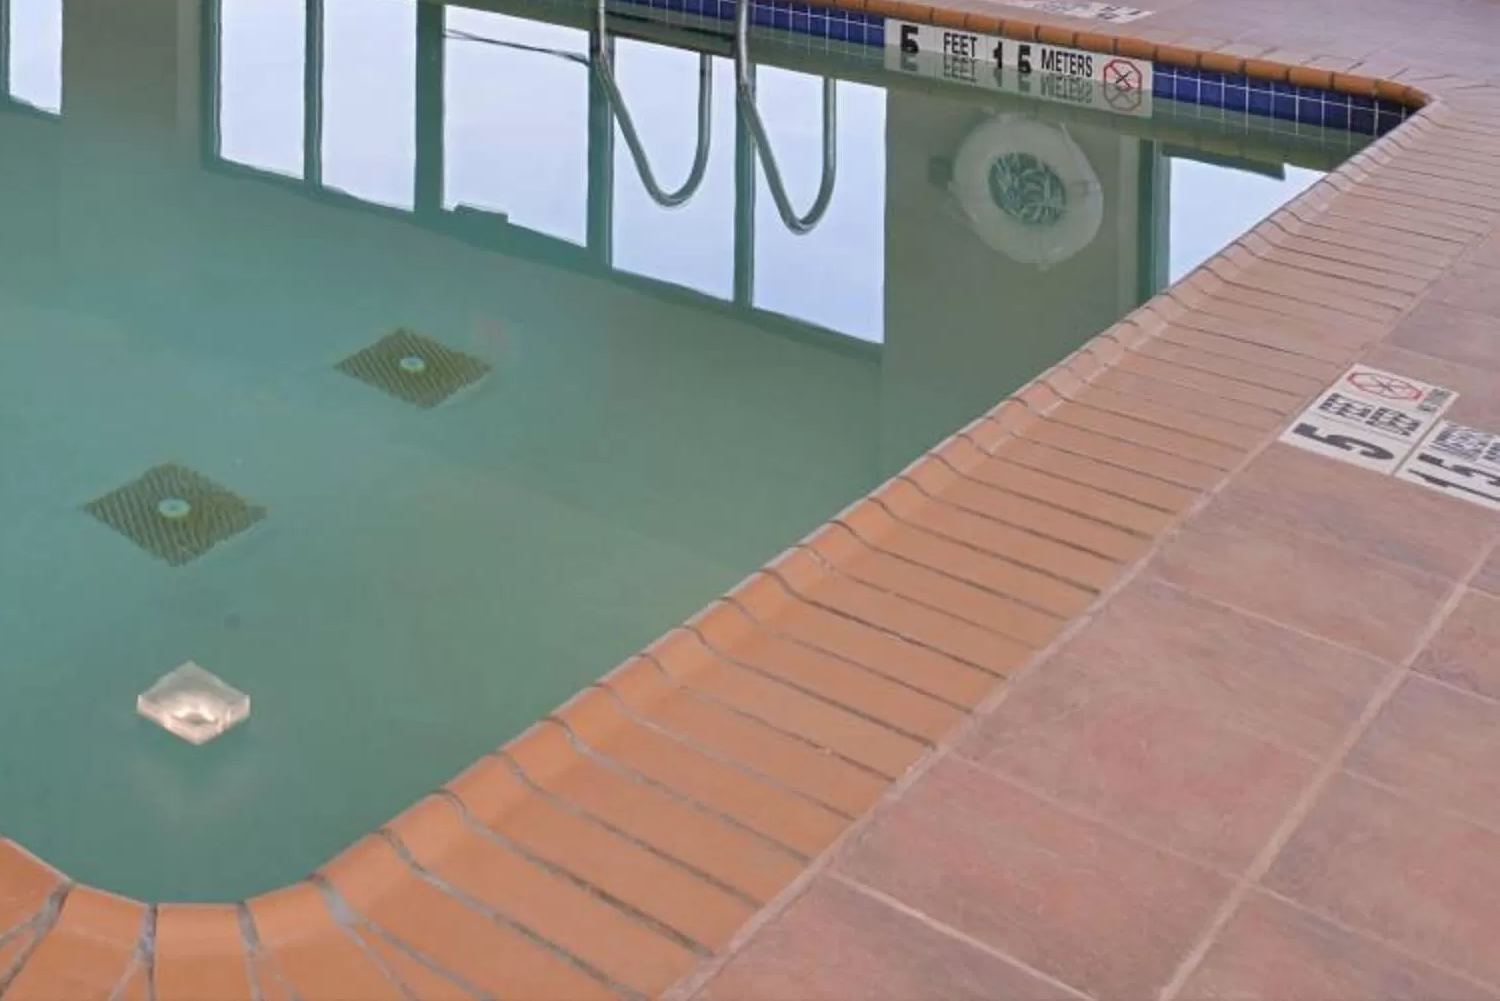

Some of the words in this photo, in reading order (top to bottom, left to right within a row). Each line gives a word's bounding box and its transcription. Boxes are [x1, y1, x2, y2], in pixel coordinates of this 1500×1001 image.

[943, 32, 978, 57] FEET
[1041, 48, 1093, 78] METERS
[1292, 423, 1395, 460] 5
